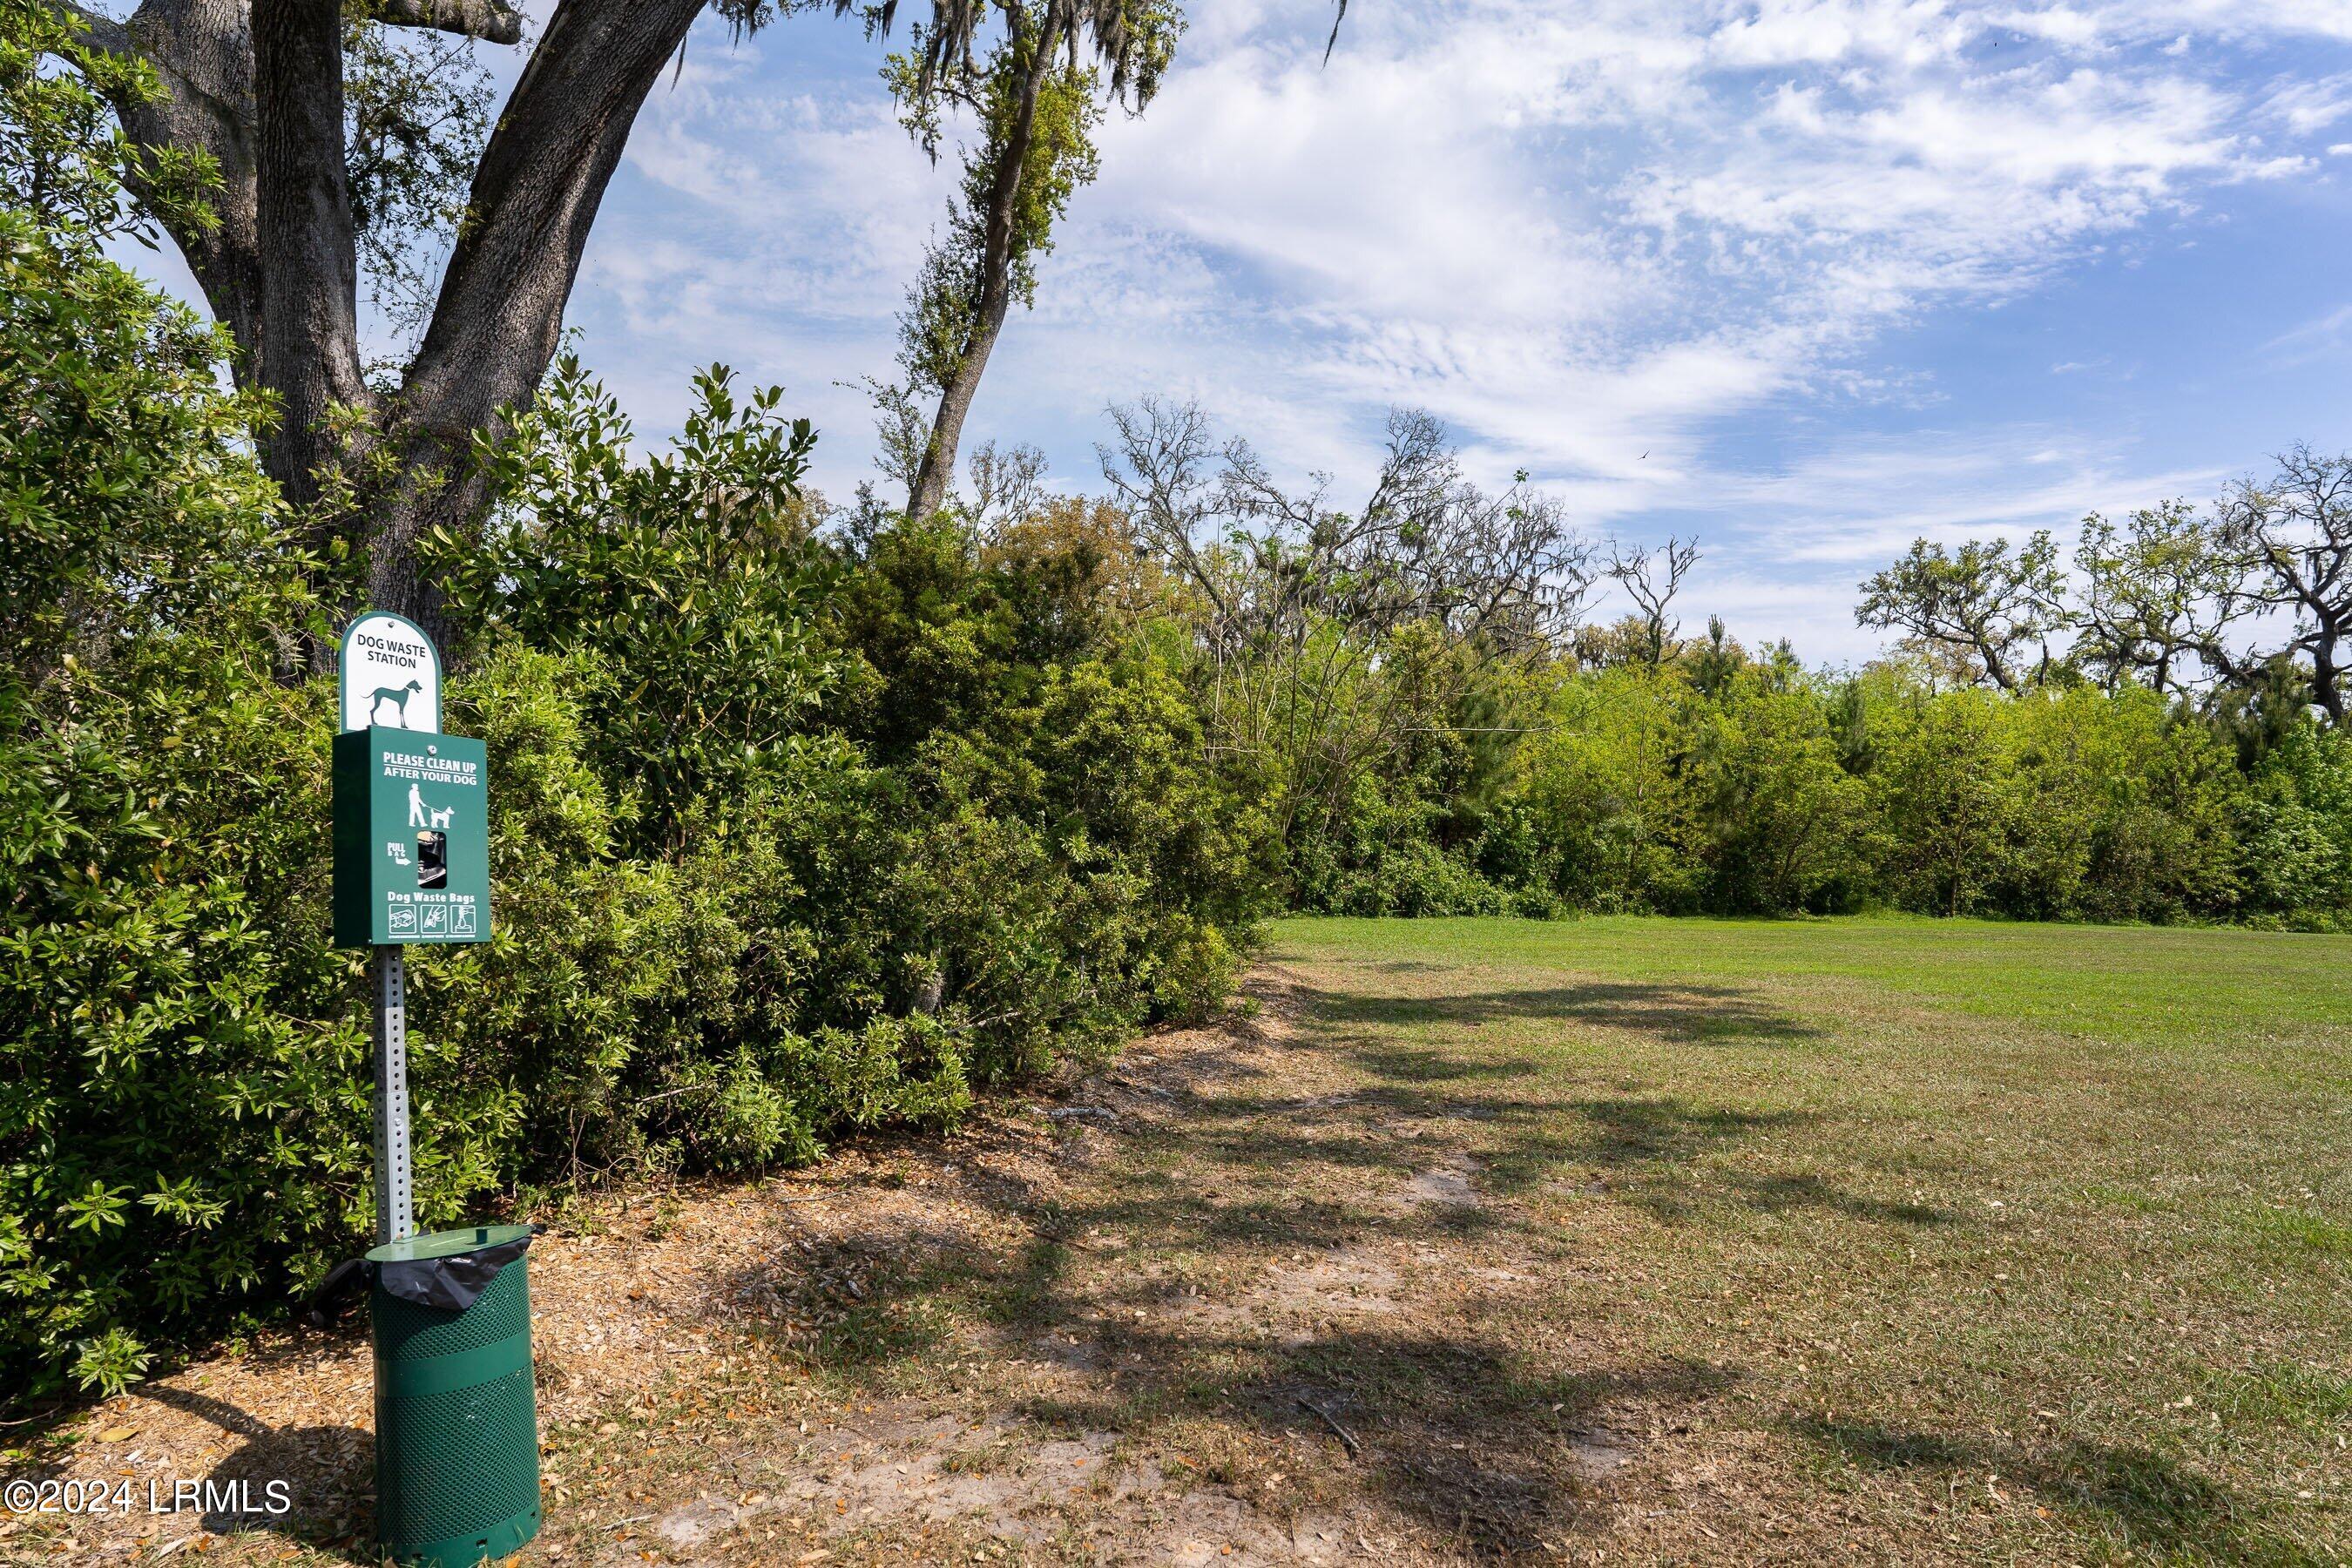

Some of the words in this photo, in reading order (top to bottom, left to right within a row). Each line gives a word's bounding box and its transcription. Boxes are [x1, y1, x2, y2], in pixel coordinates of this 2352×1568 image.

[357, 633, 384, 650] DOG
[387, 639, 426, 658] WASTE
[368, 651, 416, 669] STATION
[383, 751, 425, 767] PLEASE
[426, 756, 461, 772] CLEAN
[462, 761, 476, 774] UP
[383, 767, 420, 781] AFTER
[421, 770, 451, 783] YOUR
[453, 774, 477, 786] DOG
[388, 842, 405, 852] PULL
[388, 892, 410, 903] Dog
[413, 892, 447, 902] Waste
[449, 893, 475, 904] Bags
